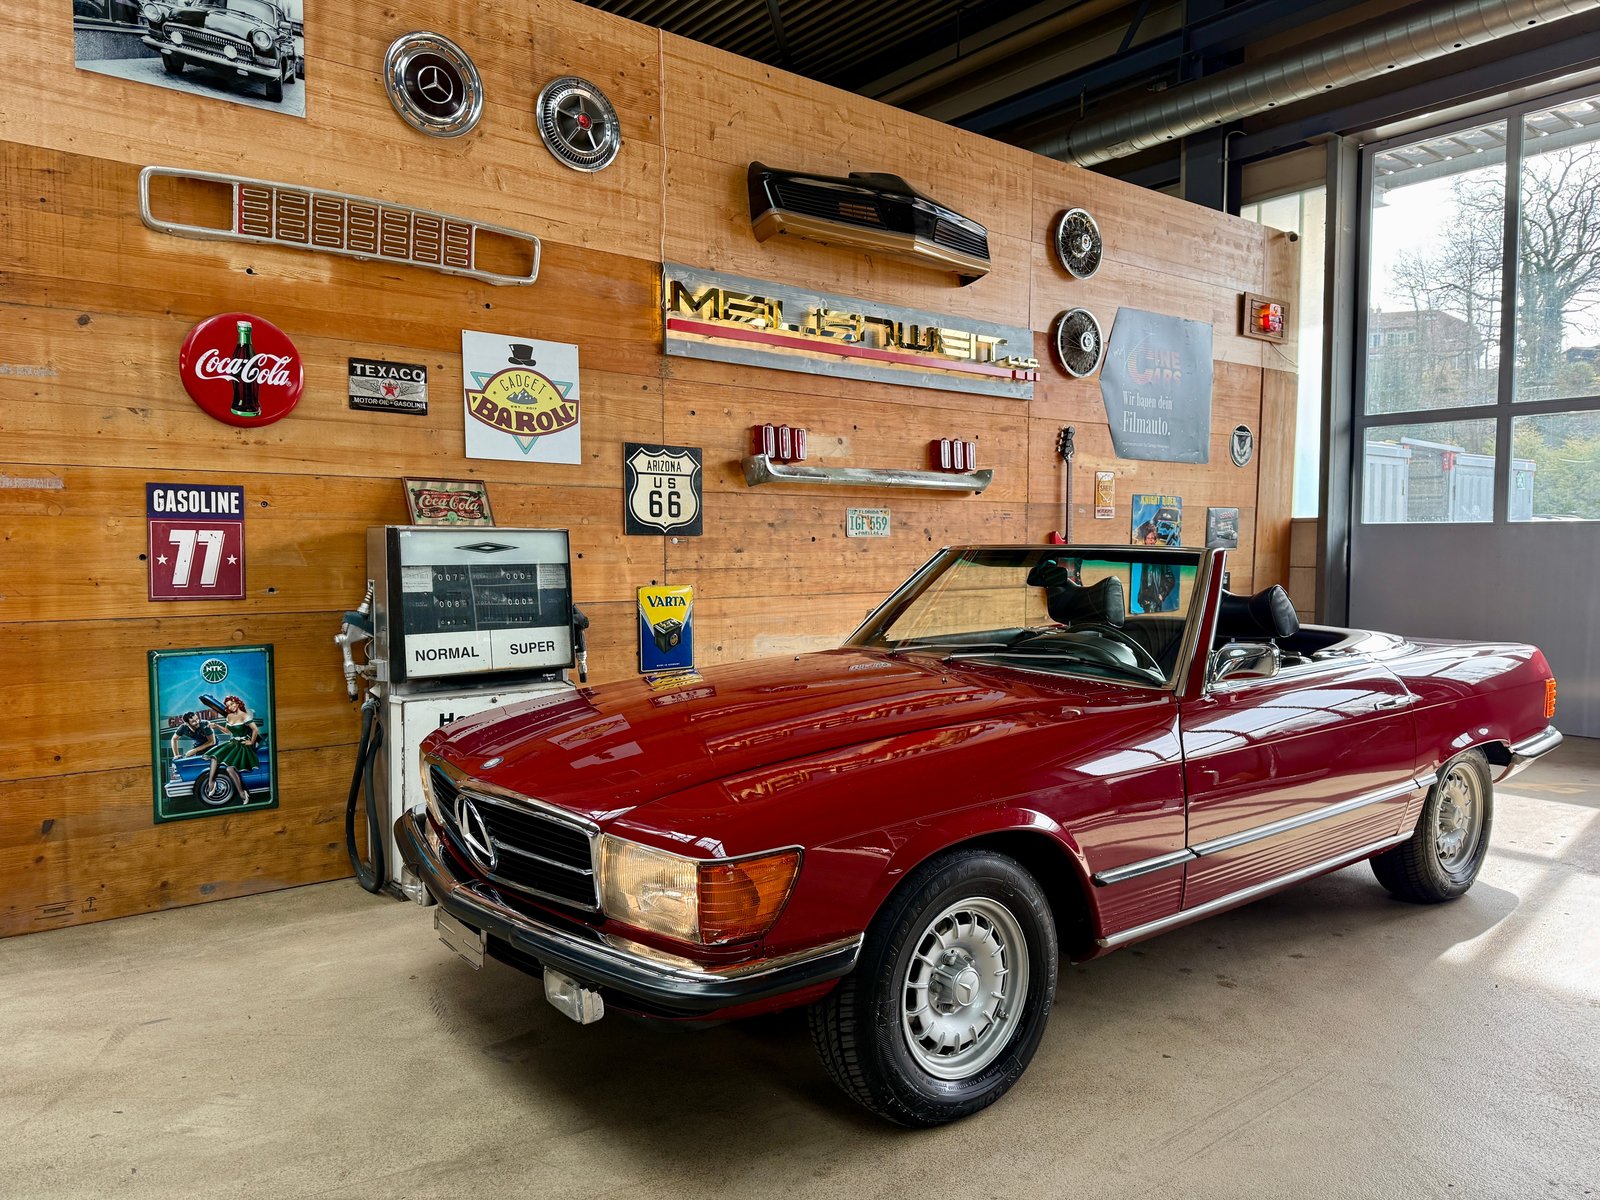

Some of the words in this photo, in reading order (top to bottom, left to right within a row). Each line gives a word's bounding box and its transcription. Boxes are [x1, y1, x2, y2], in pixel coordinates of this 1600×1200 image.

[195, 348, 292, 386] Coca-Cola
[352, 363, 425, 382] TEXACO
[499, 374, 547, 395] GADGET
[353, 397, 378, 405] MOTOR
[1122, 390, 1135, 405] Wir
[1158, 395, 1173, 410] dein
[473, 395, 575, 432] BARON
[1122, 410, 1171, 436] Filmauto.
[647, 460, 682, 473] ARIZONA
[153, 489, 240, 514] GASOLINE
[649, 490, 681, 518] 66
[647, 595, 687, 608] VARTA
[415, 646, 480, 662] NORMAL
[509, 640, 555, 655] SUPER
[440, 713, 465, 728] H
